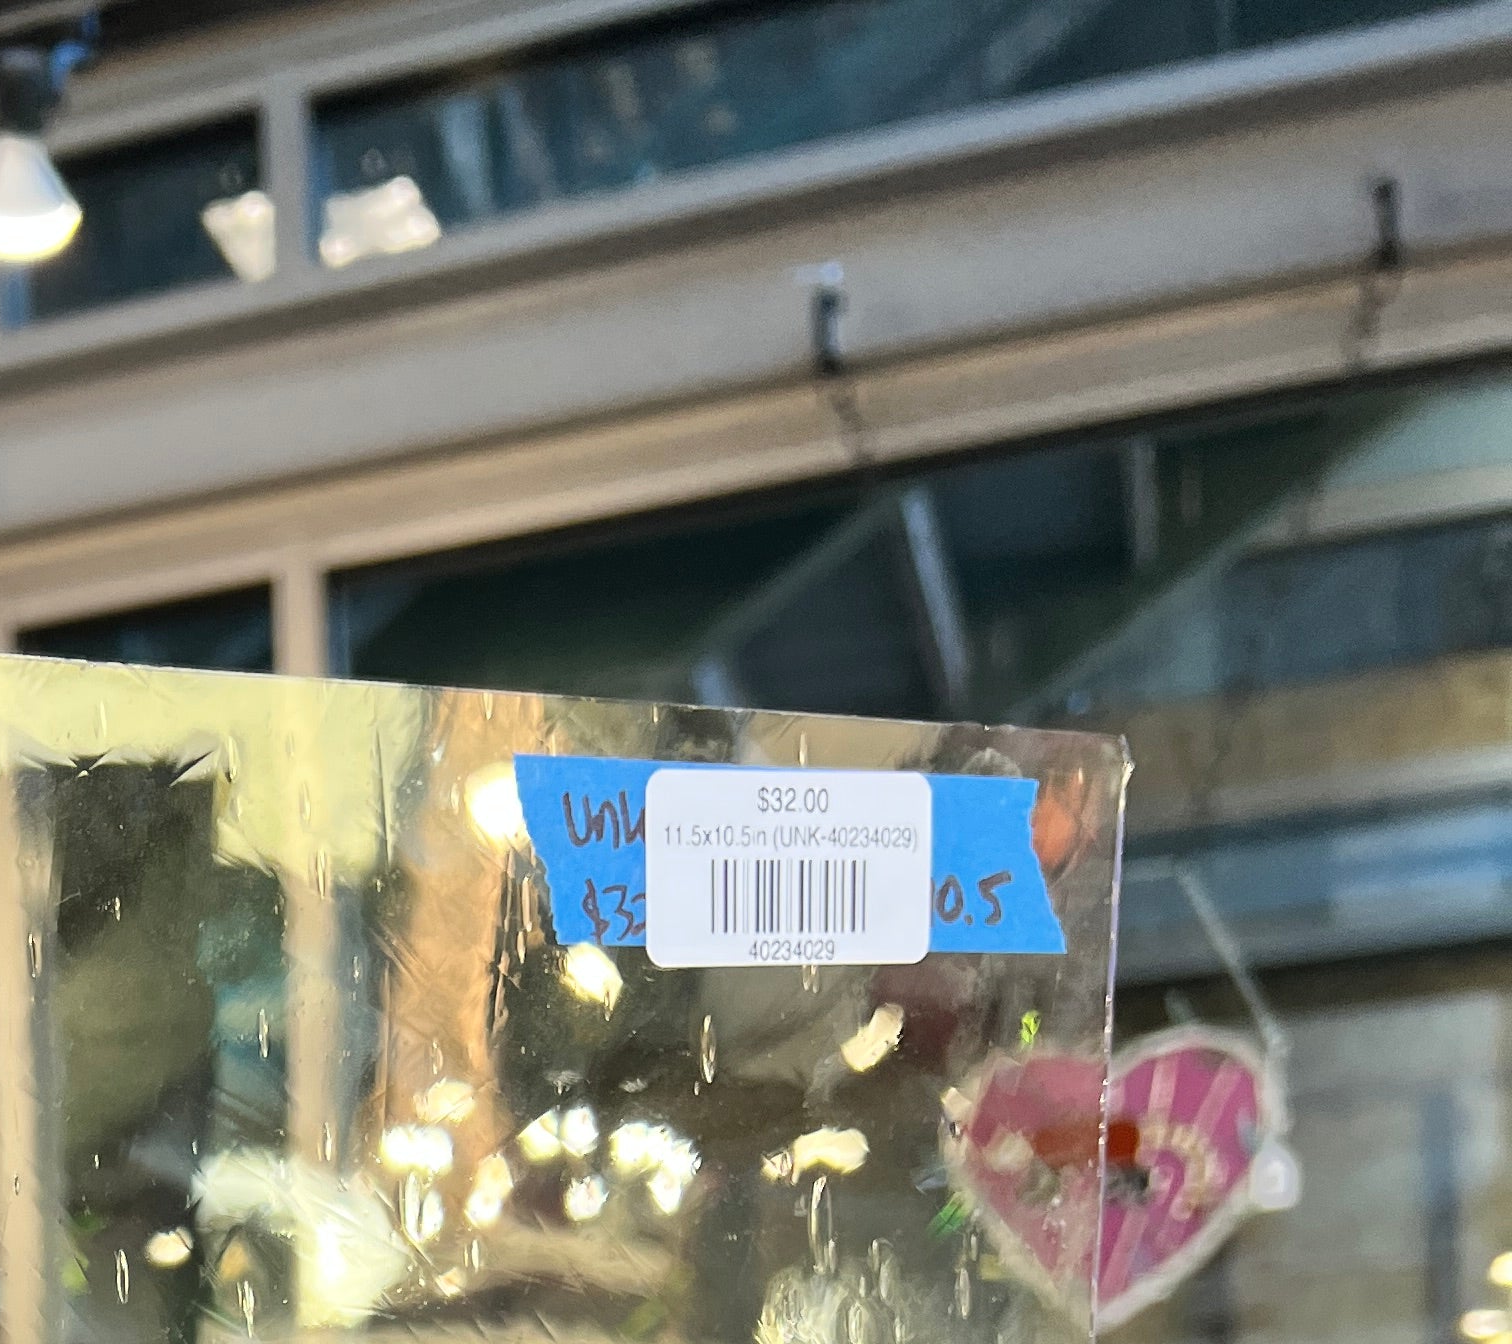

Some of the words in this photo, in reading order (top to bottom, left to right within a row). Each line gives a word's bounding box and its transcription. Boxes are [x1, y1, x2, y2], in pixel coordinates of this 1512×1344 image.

[757, 786, 829, 813] $32.00
[664, 825, 767, 847] 11.5x10.5in
[773, 826, 918, 852] (UNK-40234029)
[748, 939, 835, 960] 40234029
